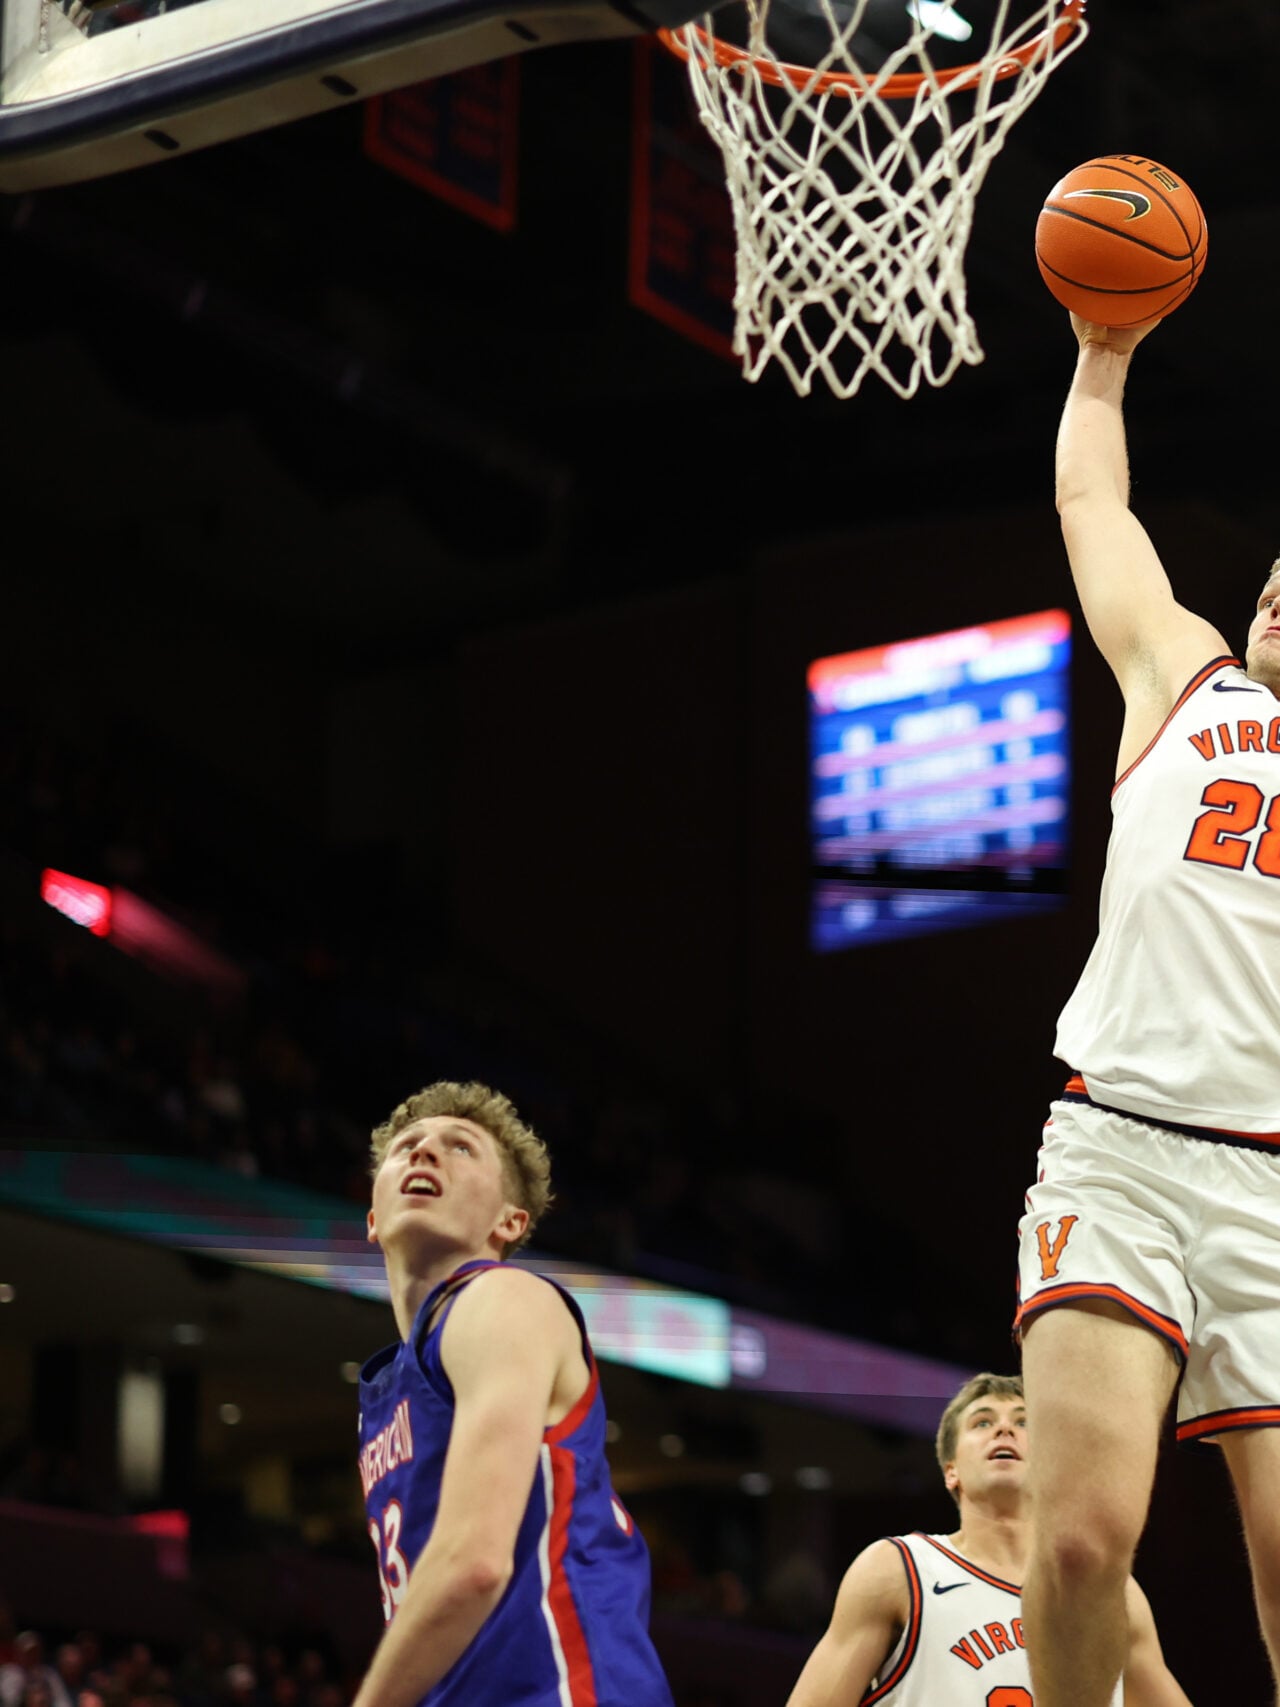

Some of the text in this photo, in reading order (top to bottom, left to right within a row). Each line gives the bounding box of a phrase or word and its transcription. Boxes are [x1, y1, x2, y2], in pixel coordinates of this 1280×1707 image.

[1100, 154, 1180, 192] LITE
[1034, 1215, 1079, 1281] V
[358, 1399, 413, 1499] MERICAN
